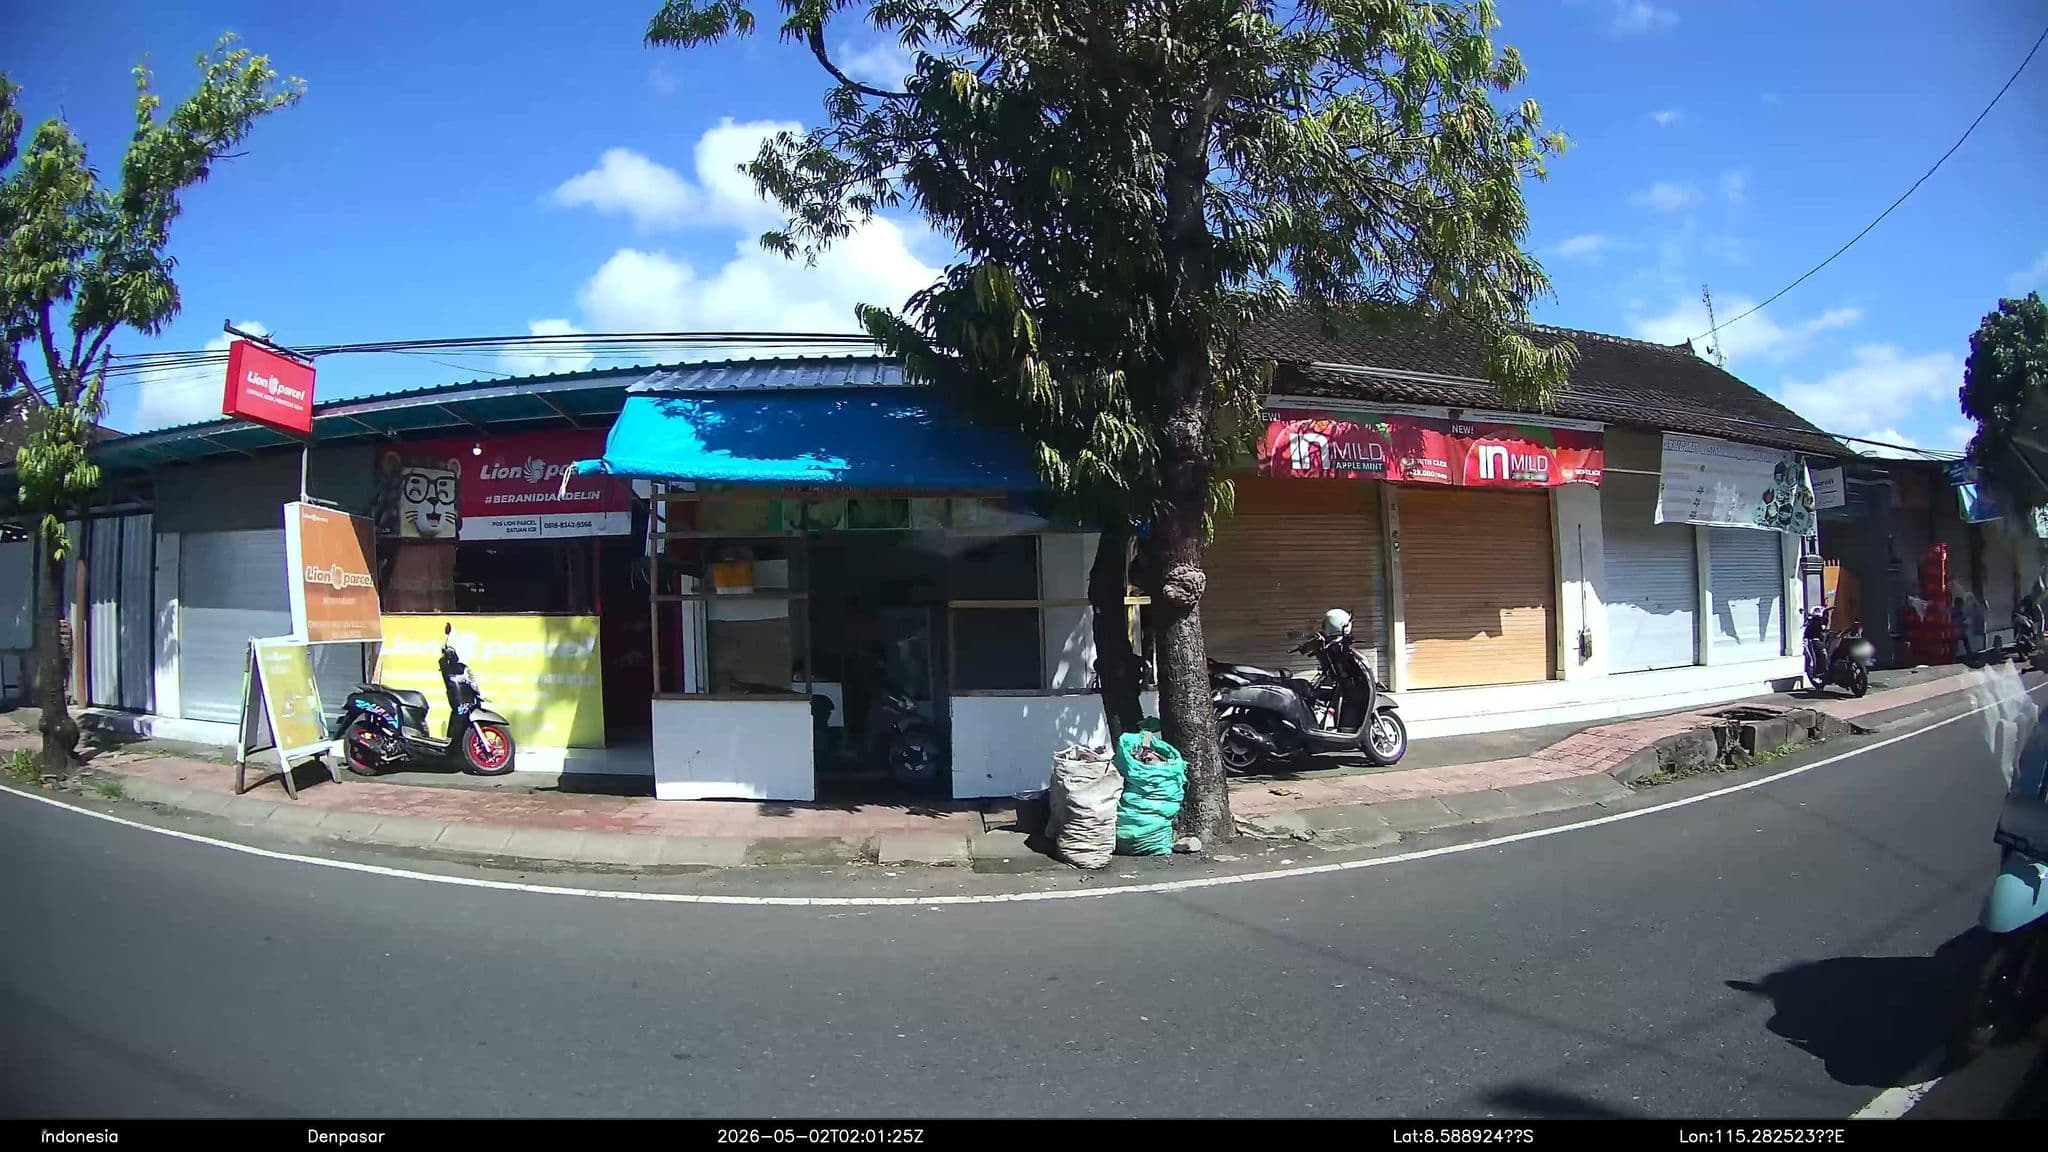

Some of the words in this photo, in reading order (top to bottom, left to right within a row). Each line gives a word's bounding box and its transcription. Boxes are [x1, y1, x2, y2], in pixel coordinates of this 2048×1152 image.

[247, 371, 269, 388] Lion
[277, 384, 306, 401] parcel
[1452, 425, 1474, 435] NEW!
[1333, 442, 1384, 461] MILD
[480, 463, 522, 480] Lion
[1336, 461, 1362, 470] APPLE
[1362, 462, 1383, 471] MINT
[1511, 453, 1549, 473] MILD
[305, 566, 332, 584] Lion
